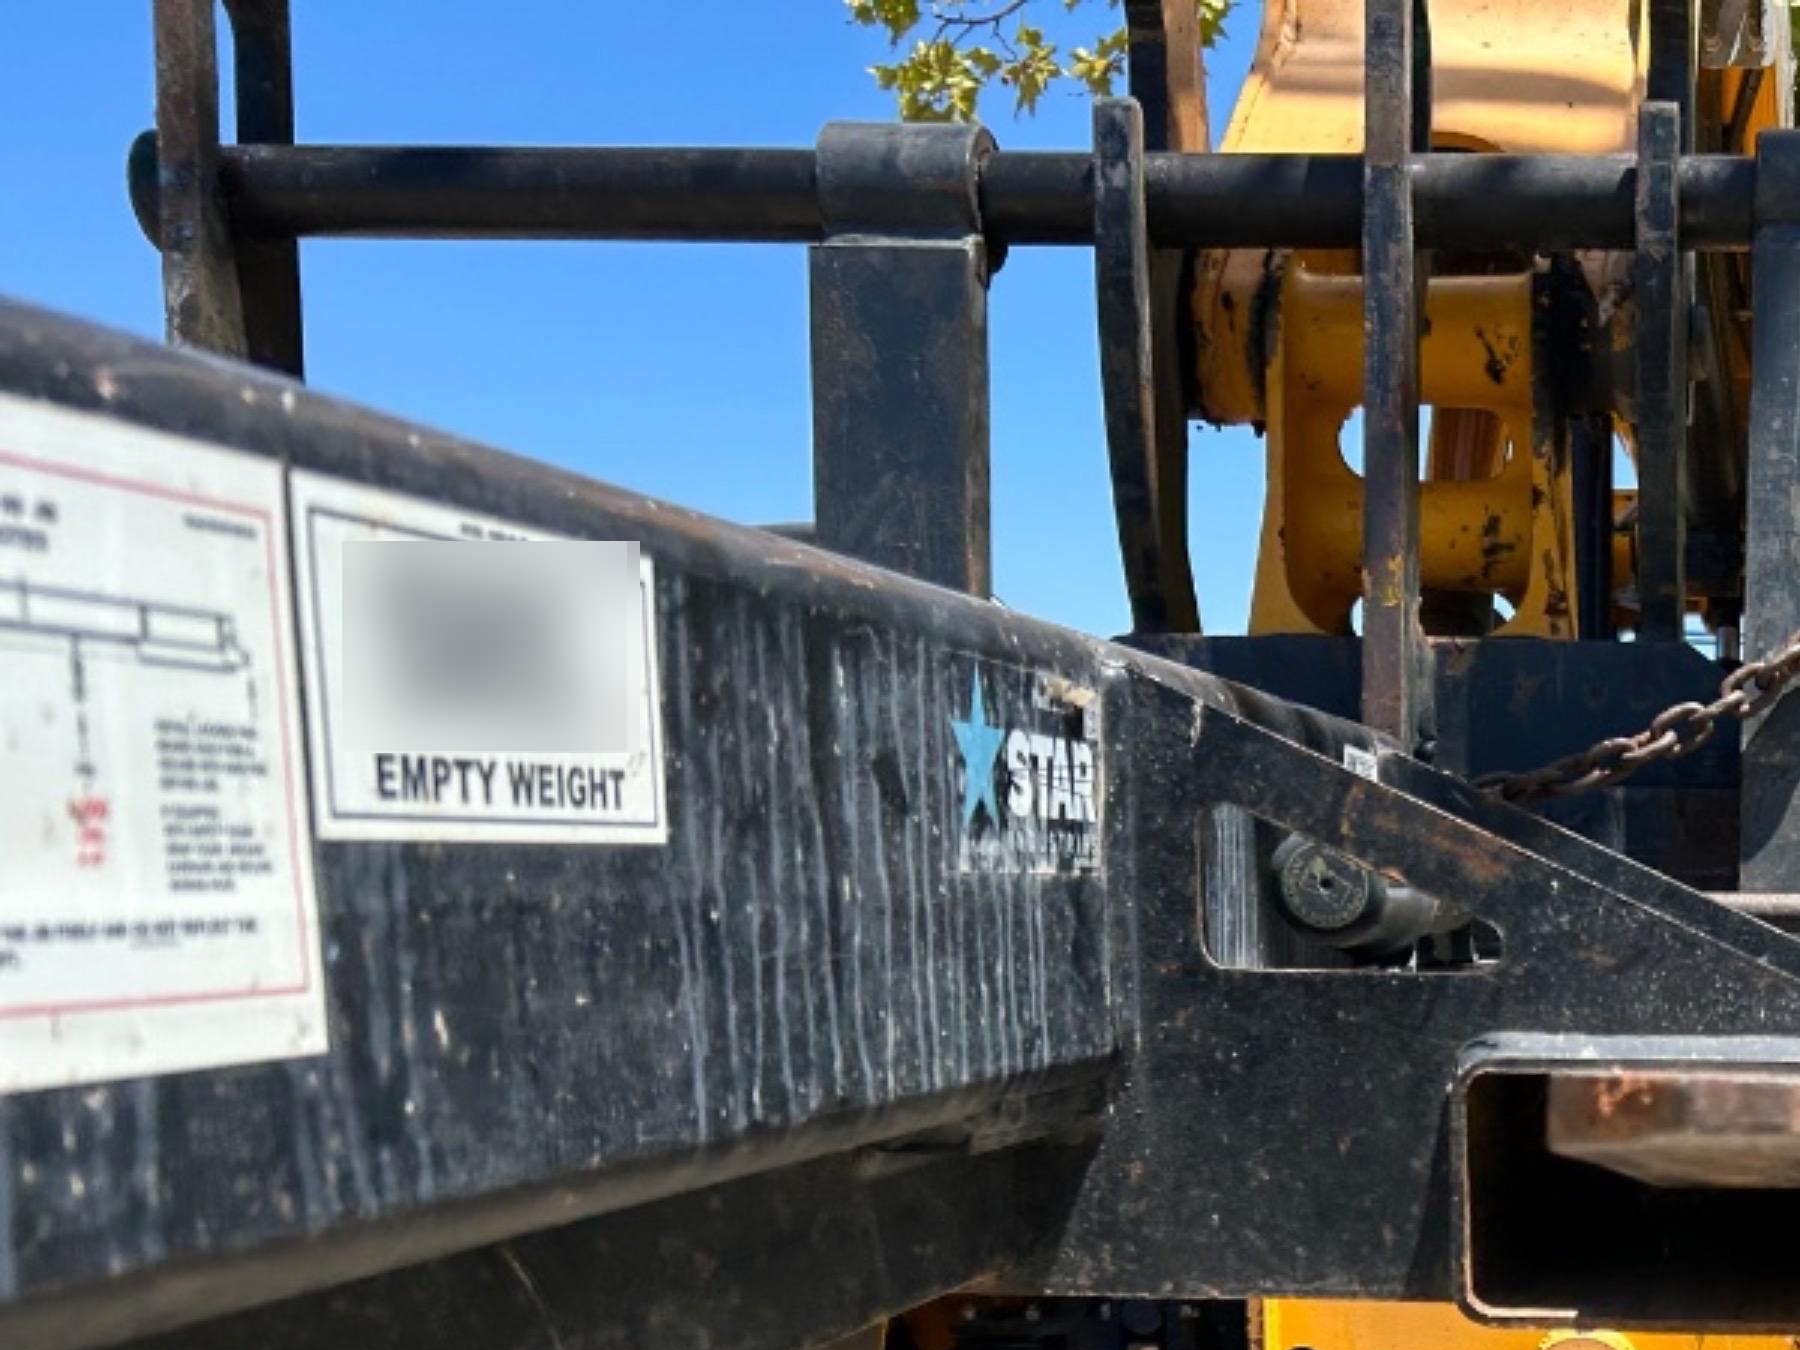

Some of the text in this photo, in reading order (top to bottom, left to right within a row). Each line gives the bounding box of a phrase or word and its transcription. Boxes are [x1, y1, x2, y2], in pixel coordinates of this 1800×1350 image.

[374, 752, 625, 811] EMPTY WEIGHT
[1007, 729, 1096, 822] STAR
